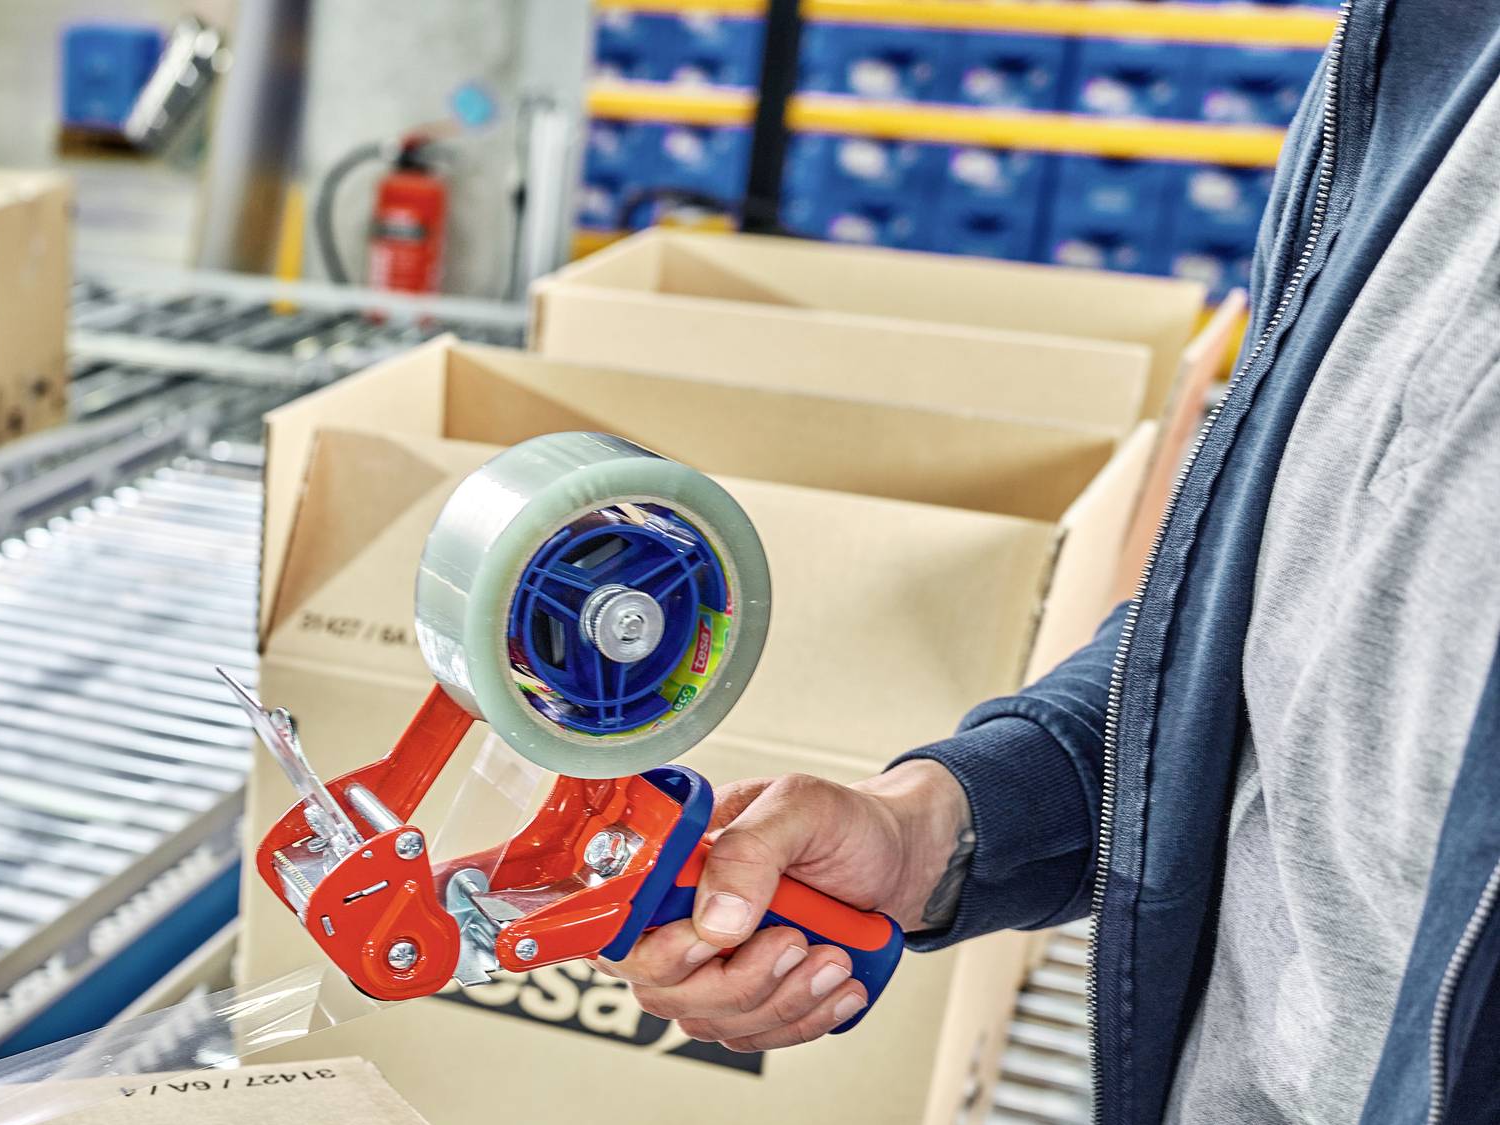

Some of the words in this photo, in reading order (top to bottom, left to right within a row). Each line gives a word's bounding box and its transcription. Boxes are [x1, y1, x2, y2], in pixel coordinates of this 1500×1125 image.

[694, 632, 710, 672] tesa
[674, 688, 692, 710] eco
[167, 1080, 211, 1093] 6A
[246, 1068, 336, 1087] 31427
